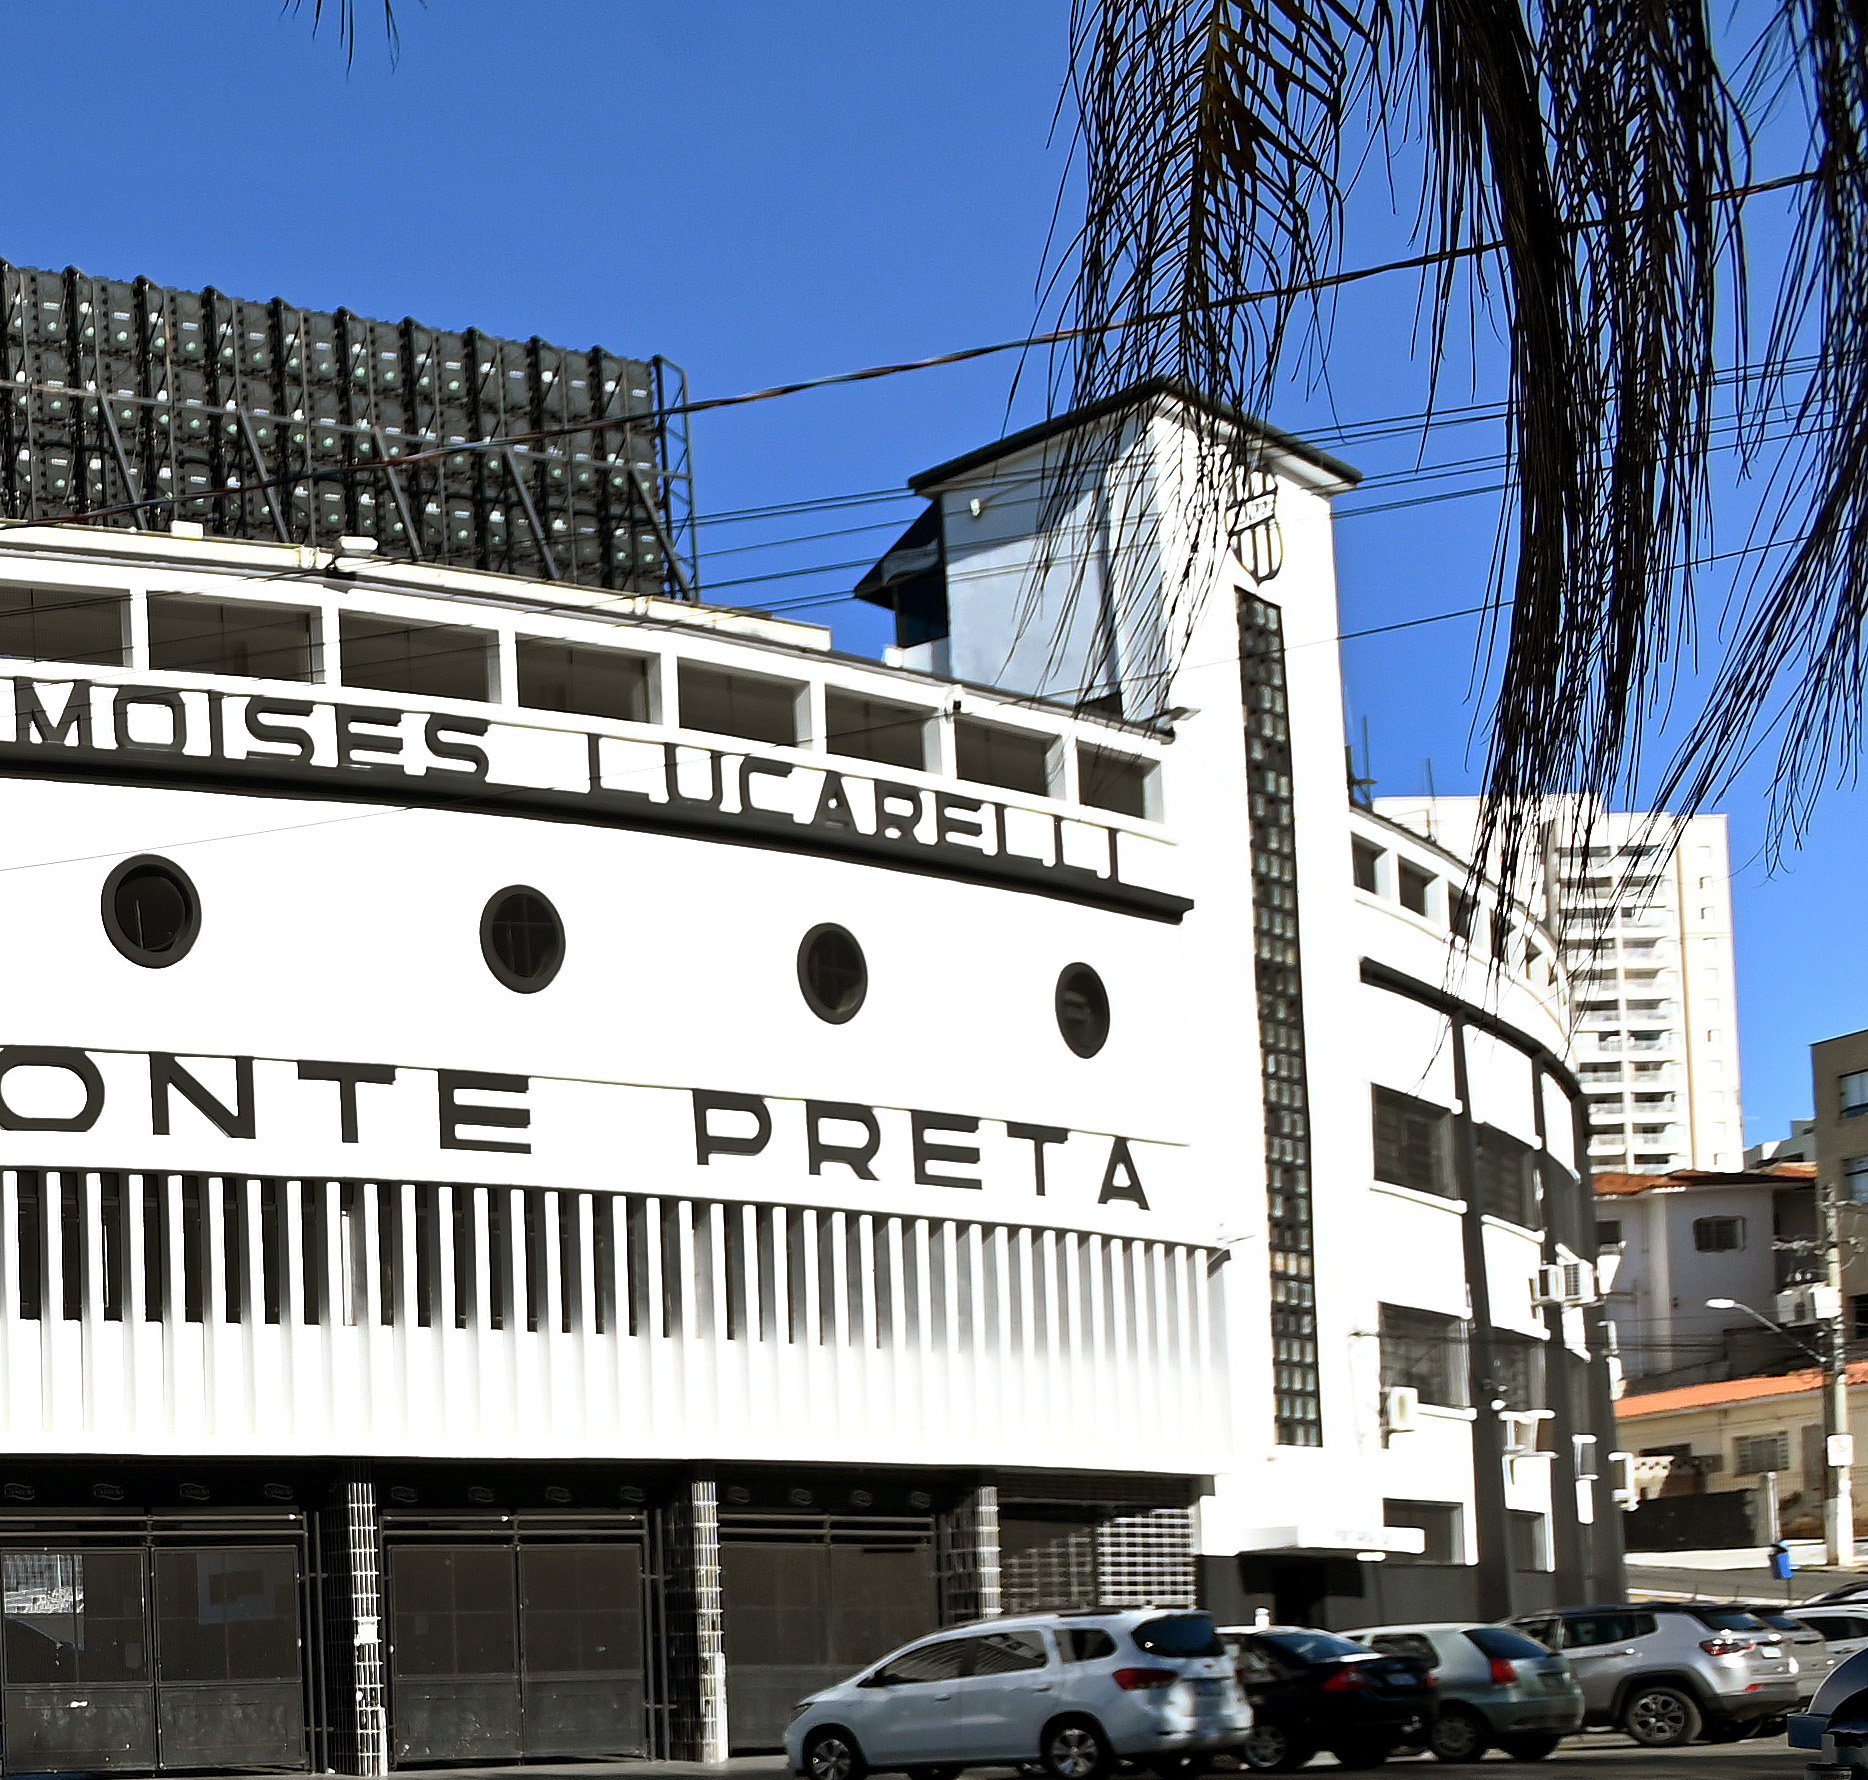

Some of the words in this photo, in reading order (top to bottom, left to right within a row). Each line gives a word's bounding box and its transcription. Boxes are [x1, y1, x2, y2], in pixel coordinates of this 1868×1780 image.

[14, 675, 492, 785] MOISES
[587, 733, 1124, 881] LUCARELLI
[693, 1088, 1152, 1211] PRETA
